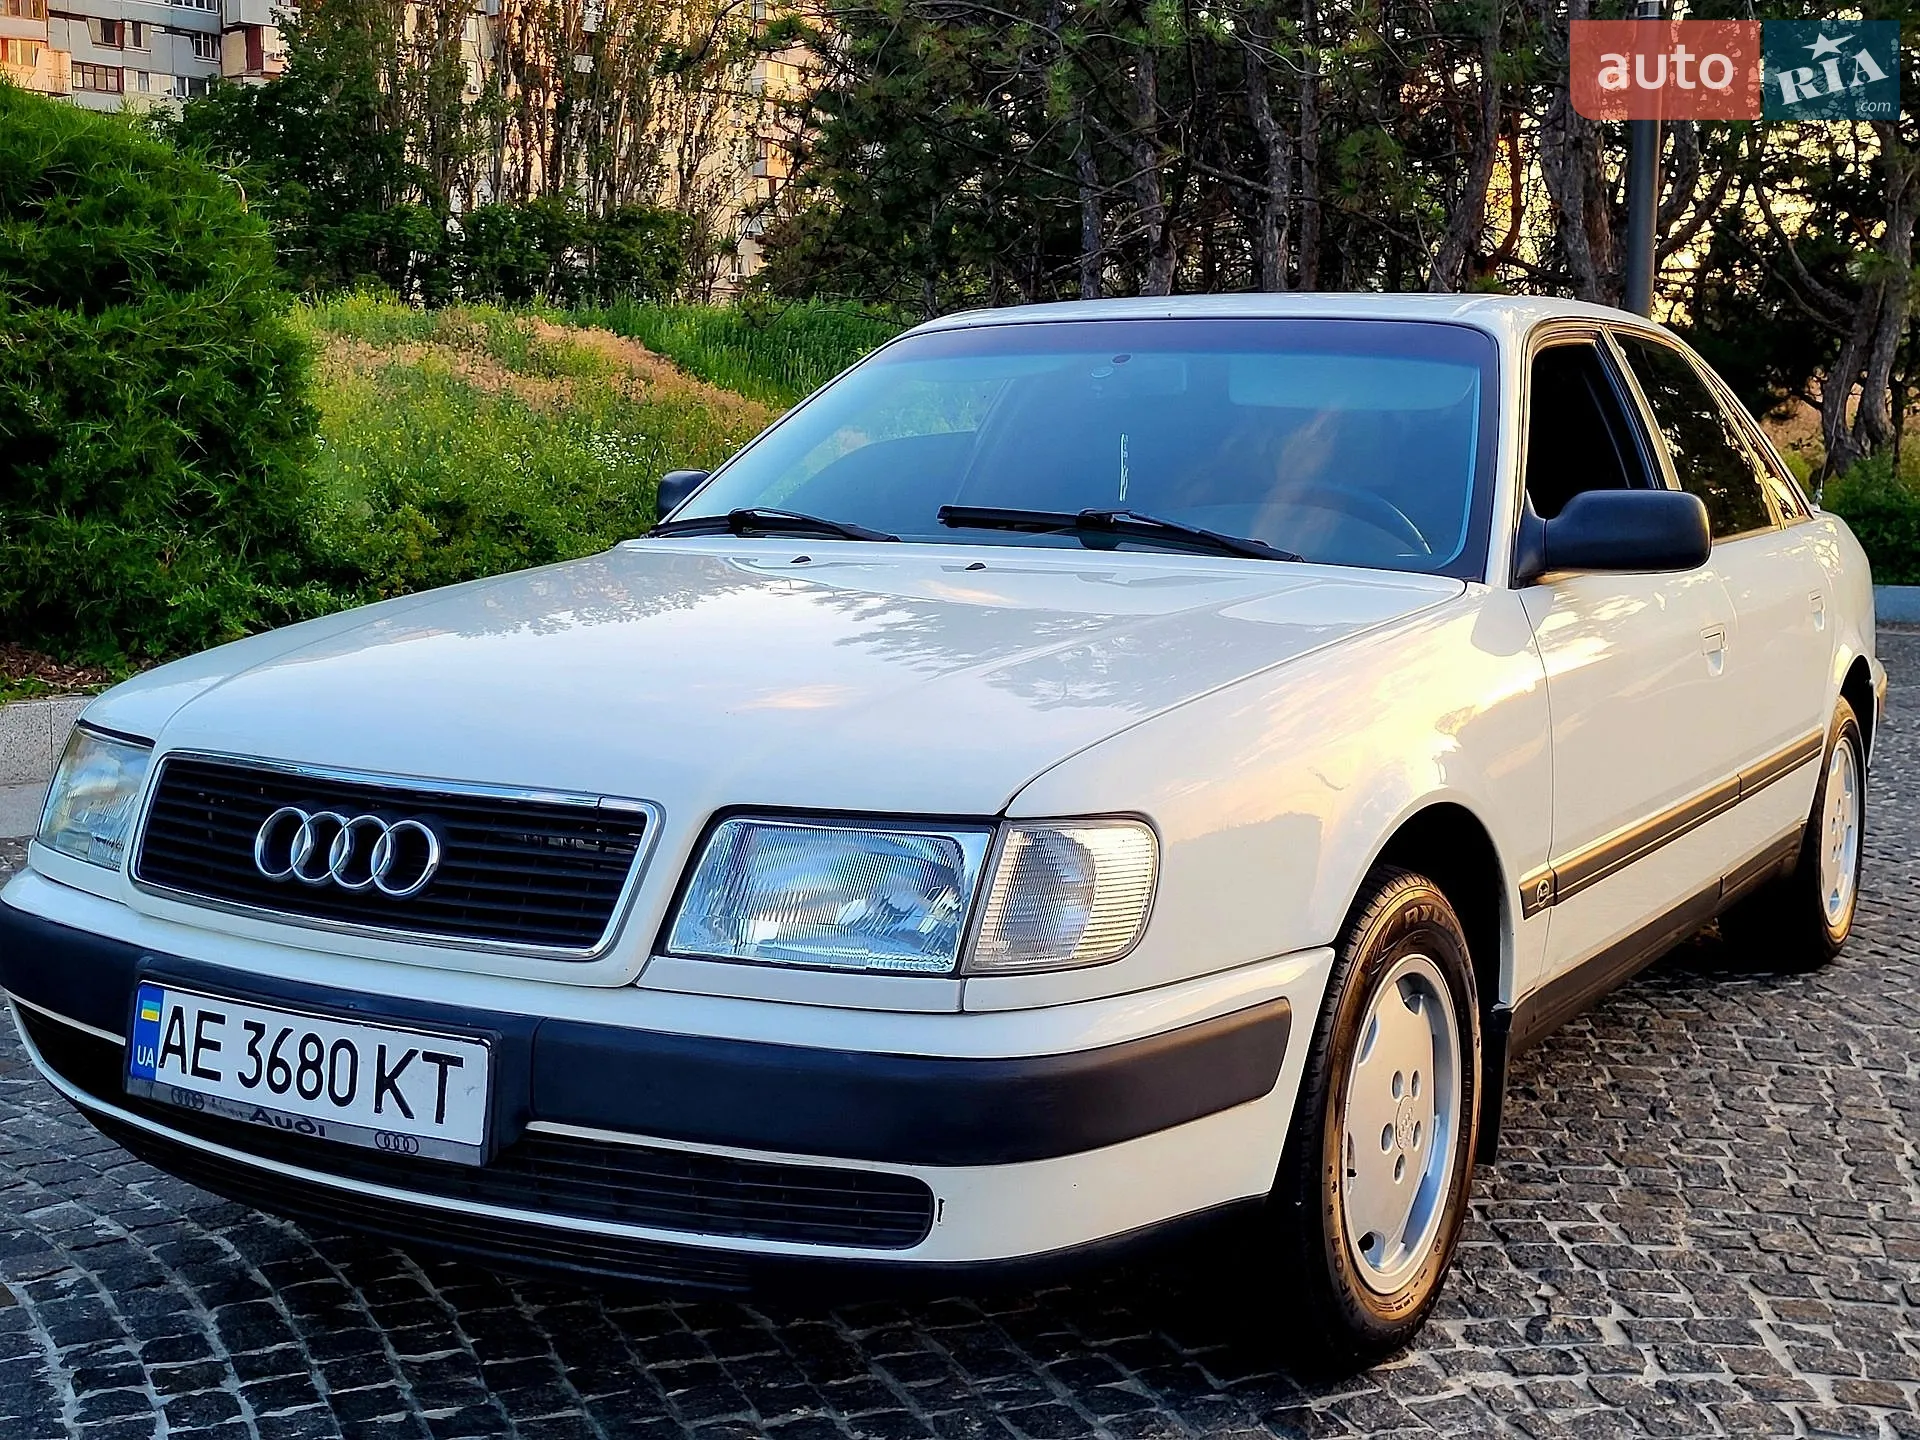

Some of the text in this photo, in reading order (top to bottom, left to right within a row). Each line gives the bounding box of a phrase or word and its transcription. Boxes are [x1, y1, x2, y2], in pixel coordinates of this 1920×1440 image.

[137, 1046, 155, 1069] UA
[158, 1005, 464, 1124] AE 3680 KT
